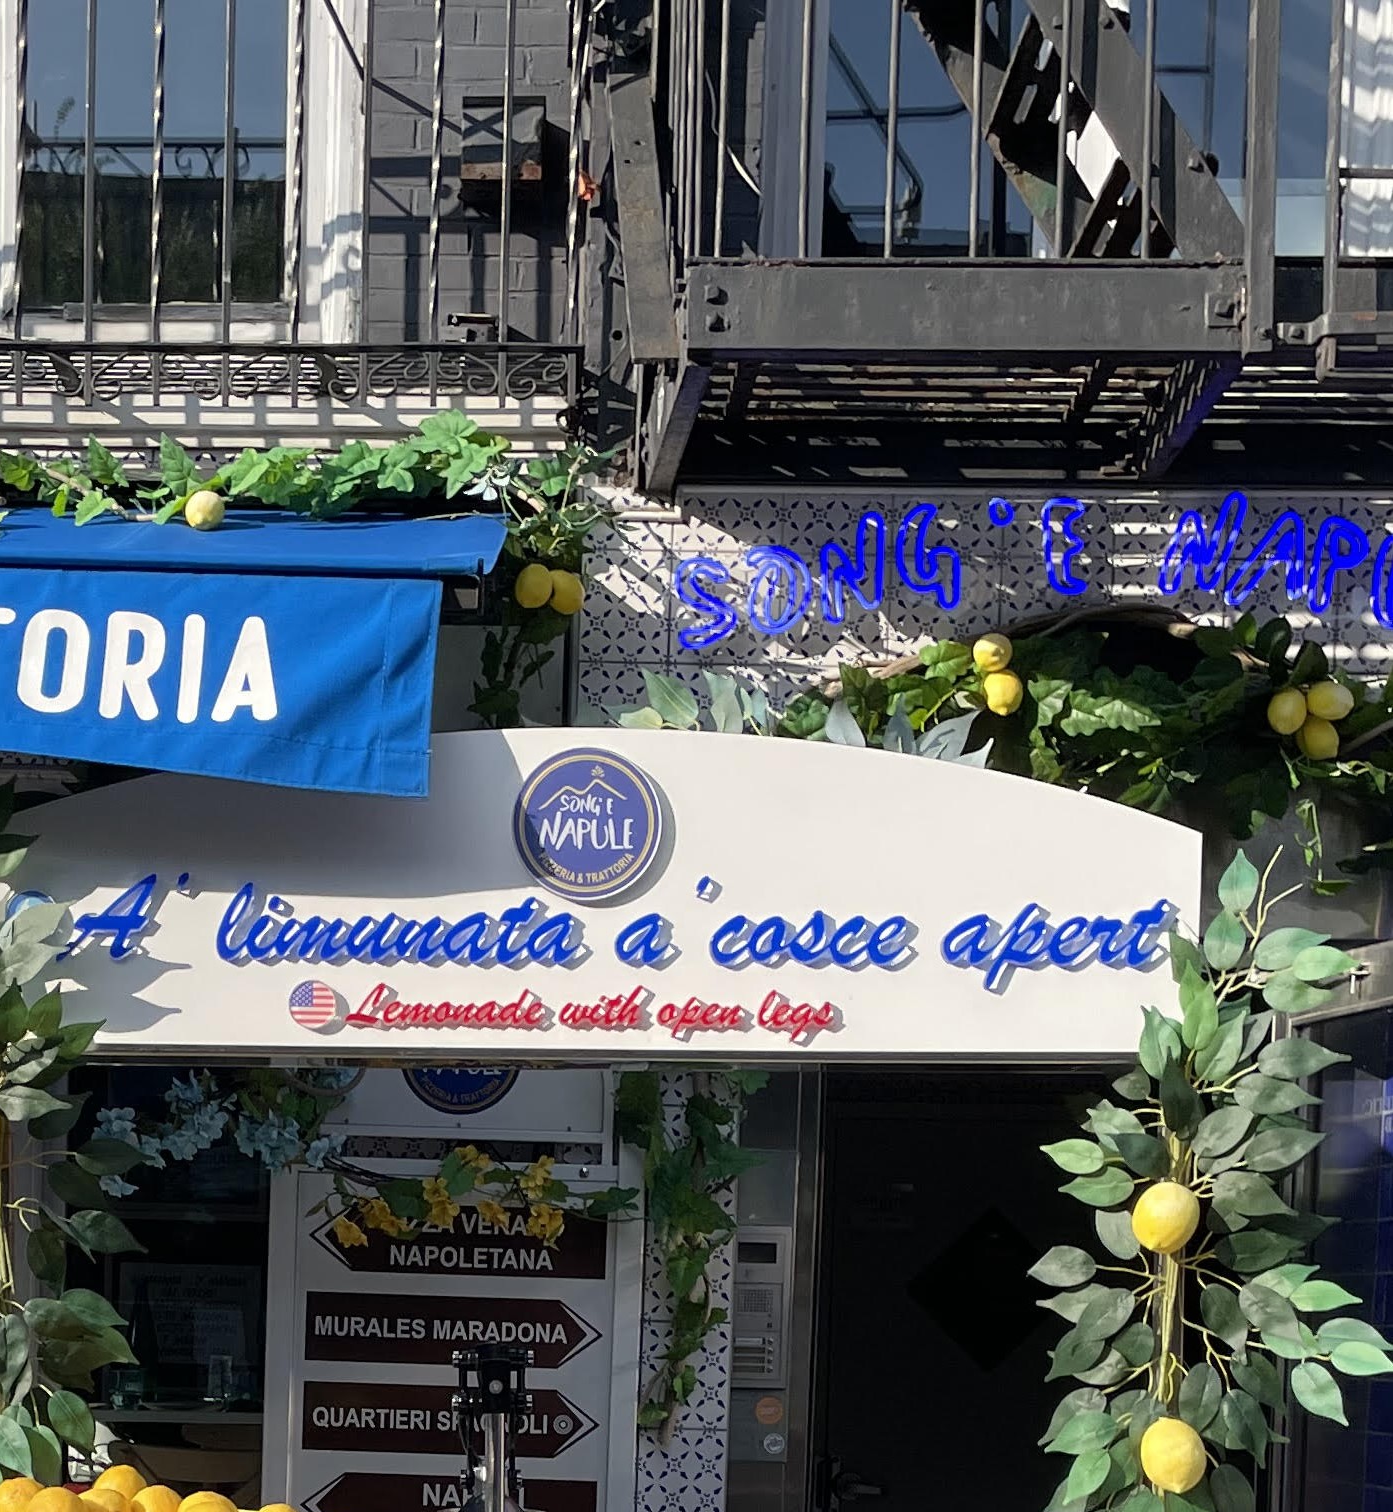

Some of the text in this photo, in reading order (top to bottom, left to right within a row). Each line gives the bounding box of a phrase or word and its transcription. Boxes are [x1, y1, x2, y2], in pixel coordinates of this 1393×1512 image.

[539, 811, 634, 851] NAPULE
[585, 852, 636, 884] TRATTORIA
[216, 882, 581, 963] limunata
[942, 898, 1168, 992] apert
[345, 983, 834, 1043] Lemonade with open legs
[389, 1244, 553, 1271] NAPOLETANA
[314, 1315, 568, 1344] MURALES MARADONA
[312, 1406, 431, 1432] QUARTIERI
